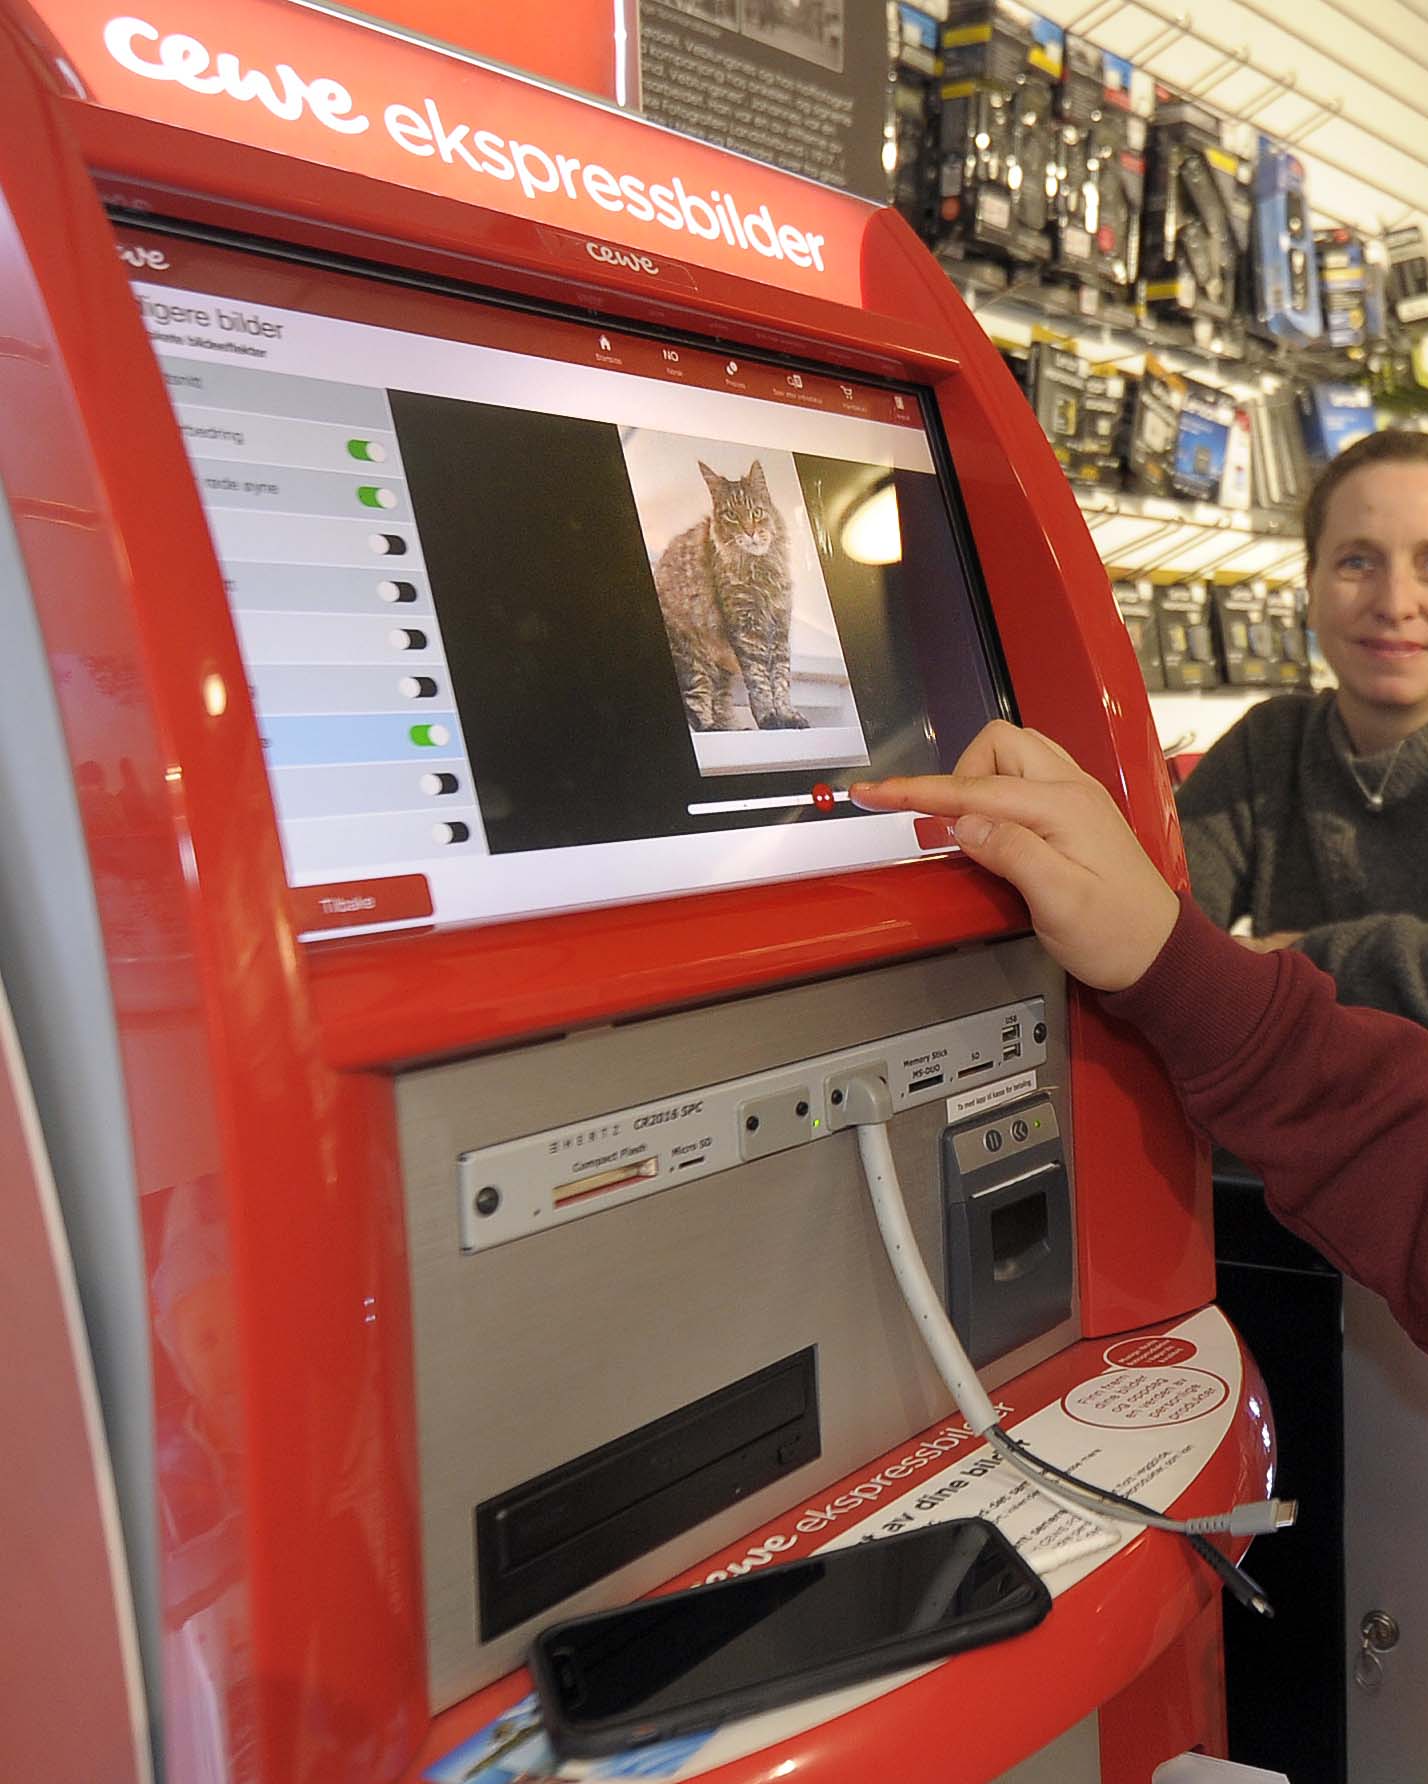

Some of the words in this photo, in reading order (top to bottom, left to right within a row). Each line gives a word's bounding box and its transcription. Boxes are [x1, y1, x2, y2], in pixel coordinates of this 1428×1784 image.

[103, 16, 370, 135] cewe
[382, 98, 825, 272] ekspressbilder
[114, 245, 171, 271] we
[585, 242, 659, 275] cewe
[215, 308, 285, 339] bilder
[662, 348, 679, 362] NO
[1004, 1015, 1018, 1025] USB
[903, 1054, 931, 1068] Memory
[931, 1048, 948, 1060] Stick
[971, 1052, 981, 1061] SD
[912, 1064, 941, 1079] MS-DUO
[680, 1101, 704, 1118] SPC
[671, 1143, 697, 1157] Micro
[699, 1136, 713, 1148] SD
[571, 1152, 618, 1174] Compact
[619, 1143, 647, 1159] Flash
[882, 1512, 914, 1533] av
[915, 1478, 969, 1511] dine
[690, 1533, 798, 1589] ewe
